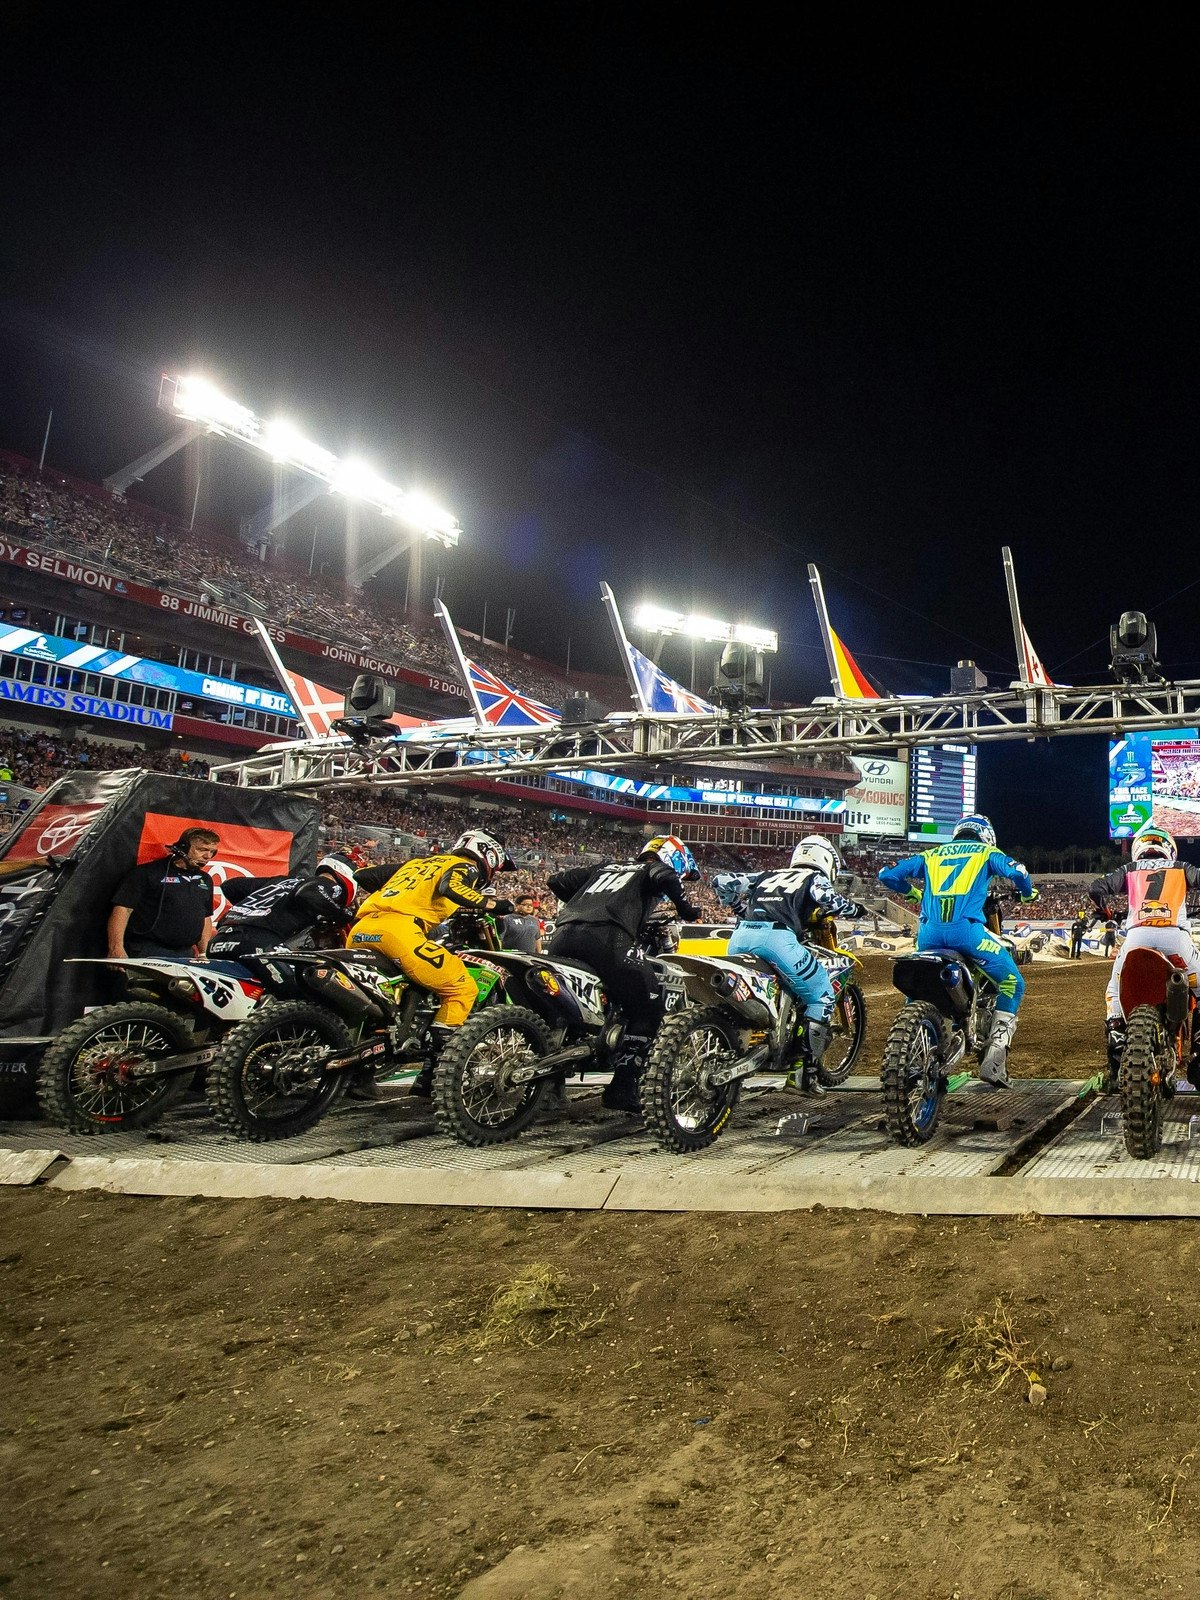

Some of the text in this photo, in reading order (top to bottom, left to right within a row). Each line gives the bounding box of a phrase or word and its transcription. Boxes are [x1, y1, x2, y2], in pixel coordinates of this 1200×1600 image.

[0, 543, 112, 590] Y SELMON
[160, 594, 286, 643] 88 JIMMIE GES
[321, 645, 400, 677] JOHN MCKAY
[202, 678, 244, 703] COMING
[245, 689, 260, 706] UP
[261, 692, 289, 712] NEXT:
[428, 678, 439, 690] 12
[71, 695, 173, 729] STADIUM
[865, 790, 905, 806] GOBUCS
[757, 869, 806, 894] 44
[939, 855, 973, 892] 7
[1144, 870, 1167, 900] 1
[823, 957, 850, 969] ZUKI
